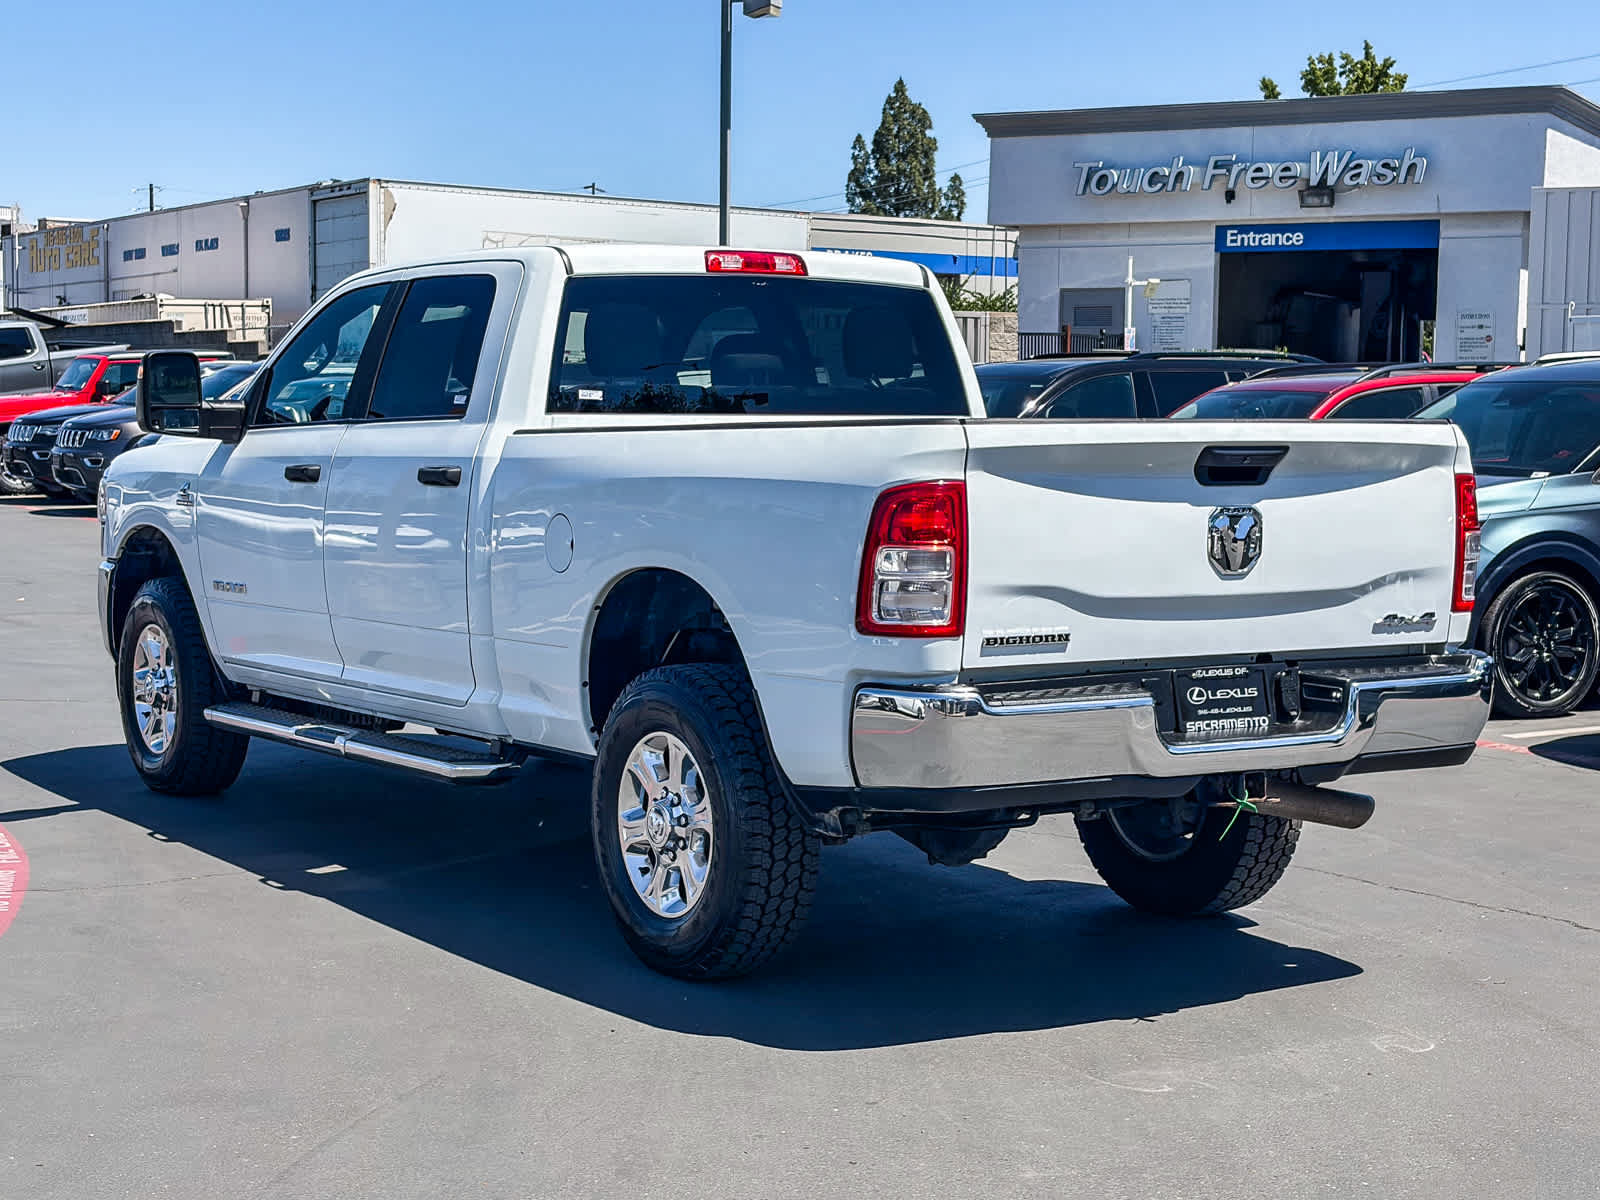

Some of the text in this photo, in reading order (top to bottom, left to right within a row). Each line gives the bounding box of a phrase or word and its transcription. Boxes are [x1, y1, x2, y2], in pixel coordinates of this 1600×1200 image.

[1073, 147, 1427, 196] Touch Free Wash
[1226, 229, 1304, 248] Entrance
[983, 633, 1071, 647] BIGHORN
[1203, 667, 1247, 678] LEXUS OF
[1207, 687, 1258, 700] LEXUS
[1186, 716, 1269, 733] SACRAMENTO
